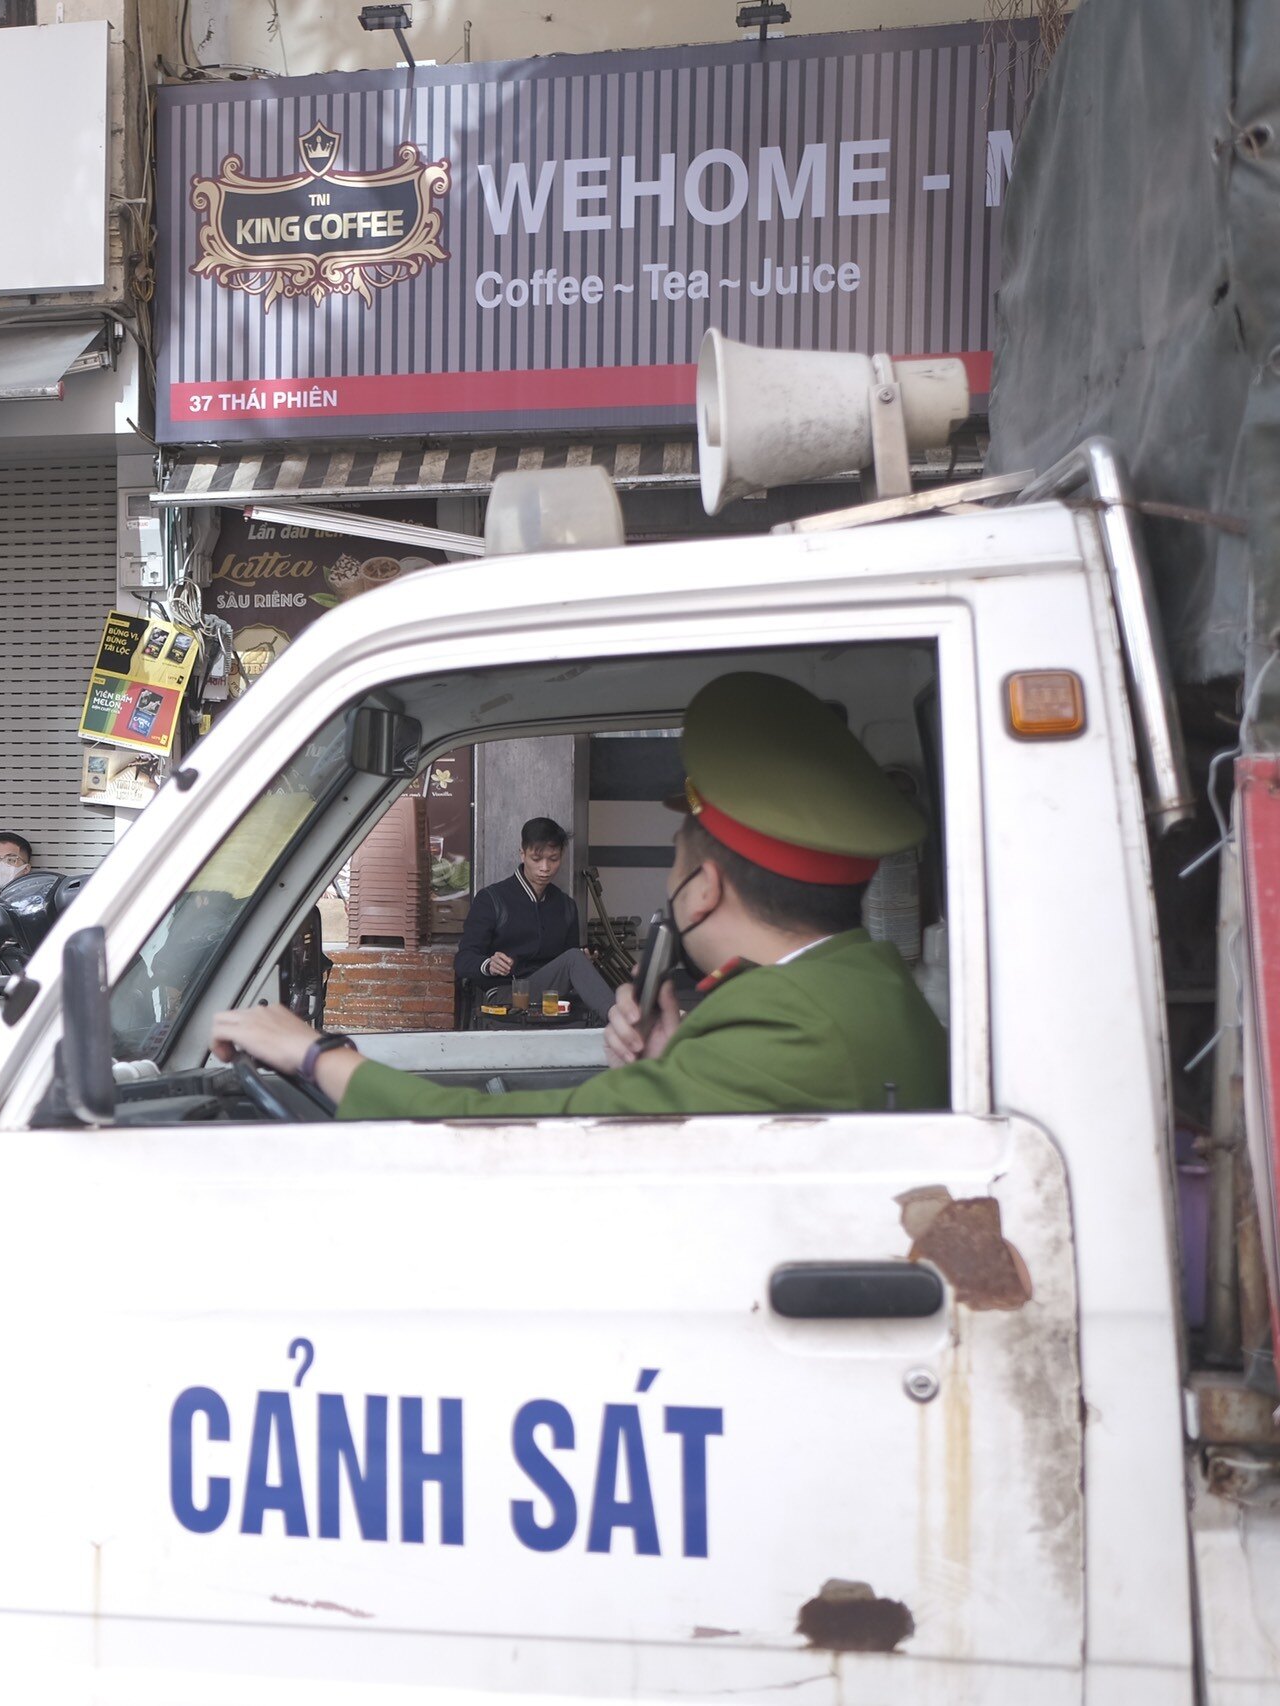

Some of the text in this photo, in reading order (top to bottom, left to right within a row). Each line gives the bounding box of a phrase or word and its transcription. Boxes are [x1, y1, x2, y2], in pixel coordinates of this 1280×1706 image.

[308, 193, 331, 206] TNI
[477, 138, 891, 236] WEHOME
[236, 209, 405, 245] KING COFFEE
[474, 268, 605, 310] Coffee
[643, 262, 710, 301] Tea
[750, 254, 862, 298] Juice
[189, 385, 338, 412] 37 THÁI PHIÊN
[247, 522, 276, 540] Lần
[212, 551, 317, 587] Lattea
[254, 590, 307, 608] RIÊNG
[168, 1336, 724, 1559] CẢNH SÁT
